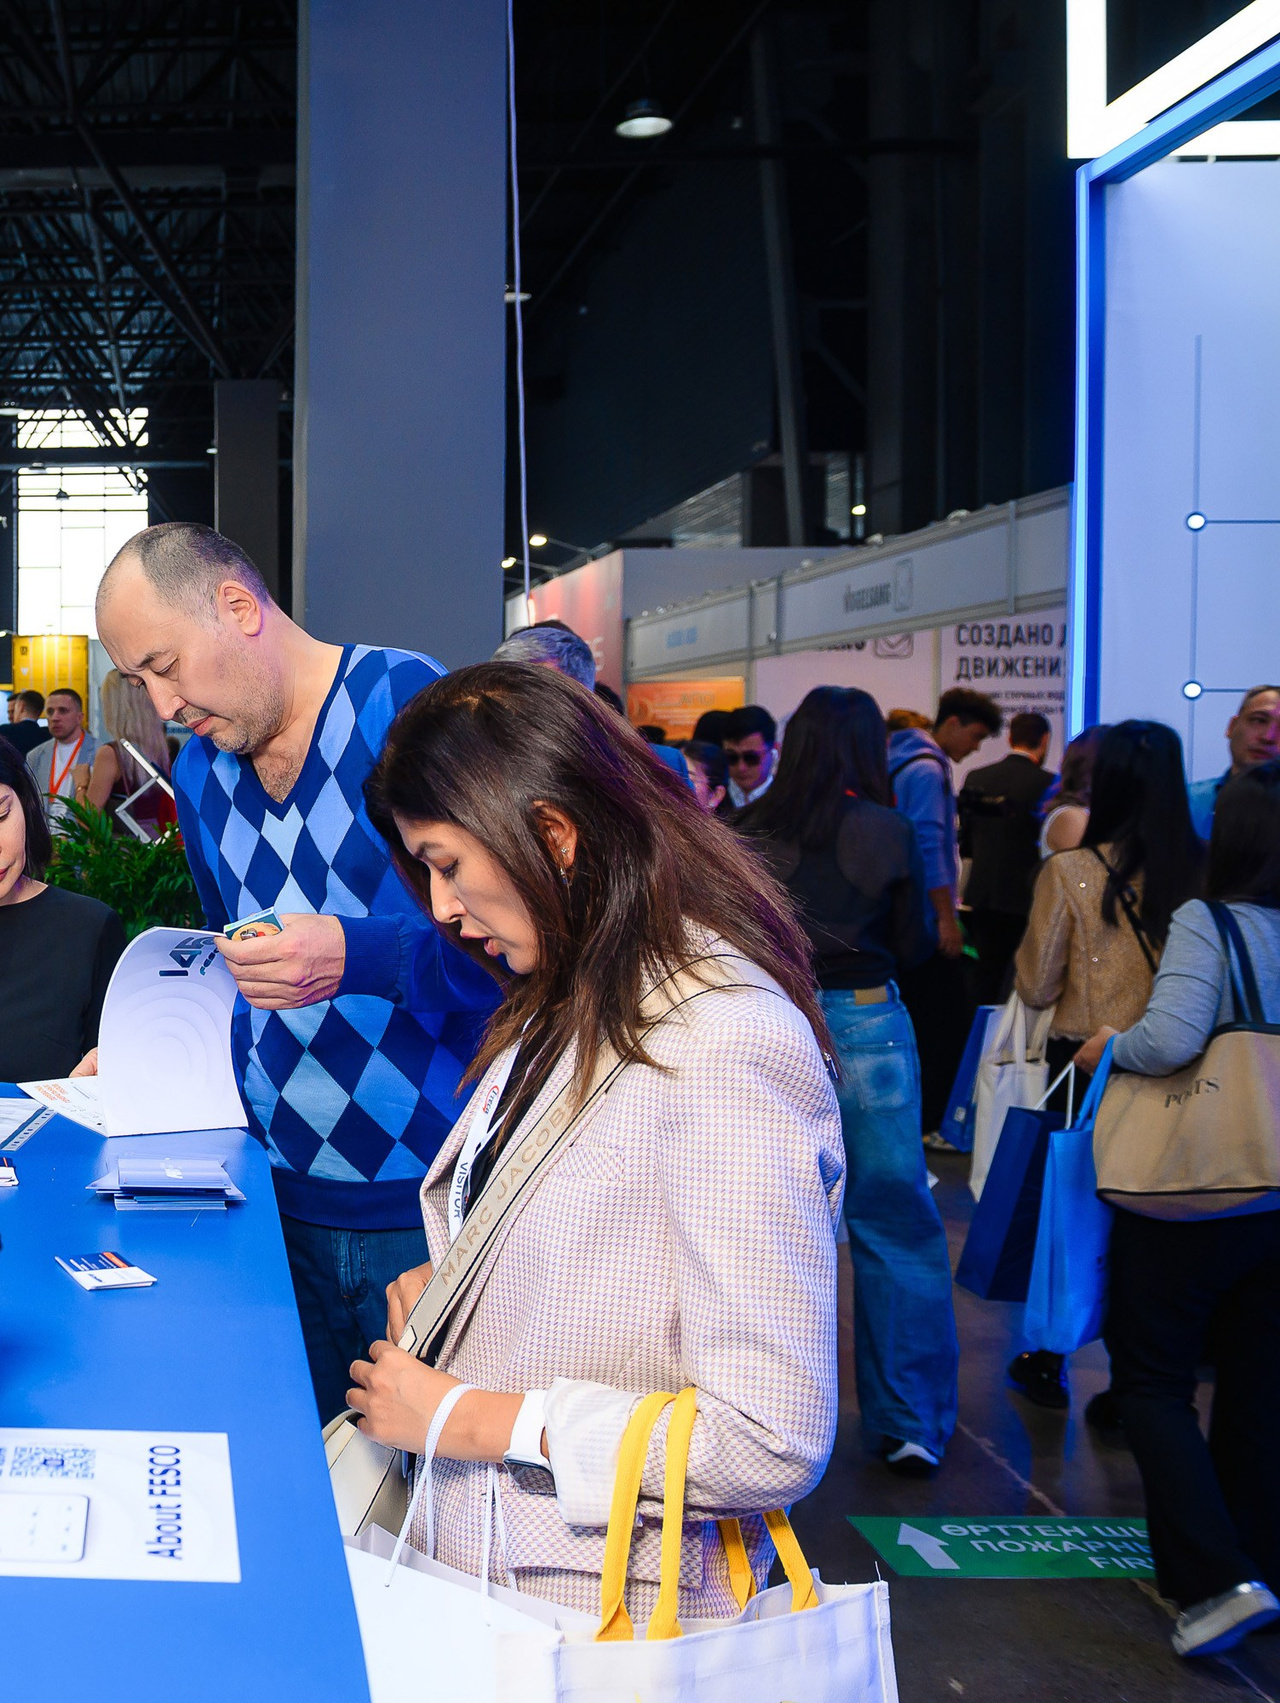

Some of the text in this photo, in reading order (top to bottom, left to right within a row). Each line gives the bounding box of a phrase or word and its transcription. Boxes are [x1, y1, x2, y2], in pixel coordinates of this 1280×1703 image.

[956, 623, 1053, 648] СОЗДАНО
[956, 656, 1066, 681] ДВИЖЕНИ
[158, 936, 217, 977] 145
[440, 1206, 493, 1286] MARC
[145, 1445, 183, 1560] About FESCO
[1088, 1556, 1156, 1570] FIR
